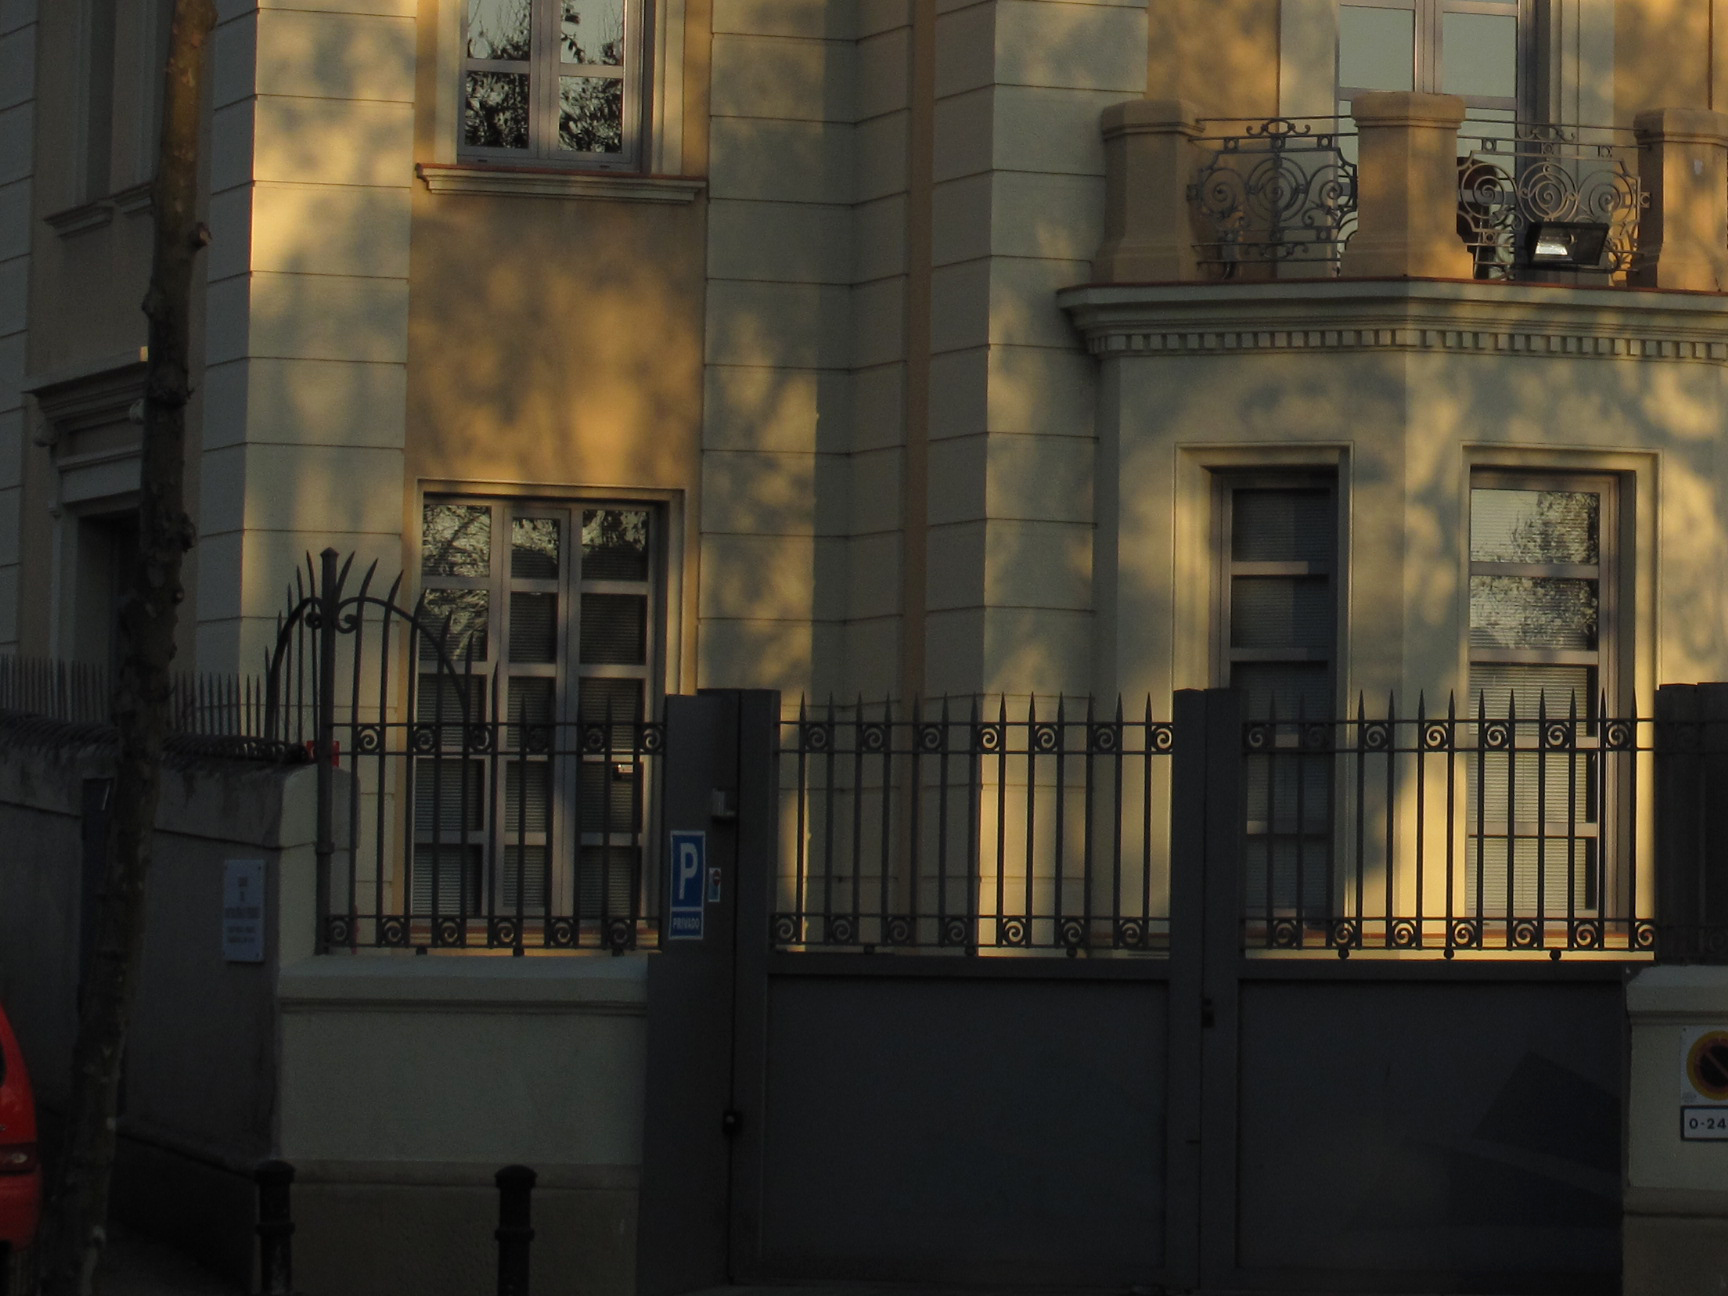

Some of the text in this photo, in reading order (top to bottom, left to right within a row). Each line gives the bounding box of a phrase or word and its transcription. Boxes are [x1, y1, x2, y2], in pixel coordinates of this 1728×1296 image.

[678, 842, 698, 900] P
[673, 917, 700, 929] PRIVADO
[1689, 1118, 1727, 1130] 0-24
